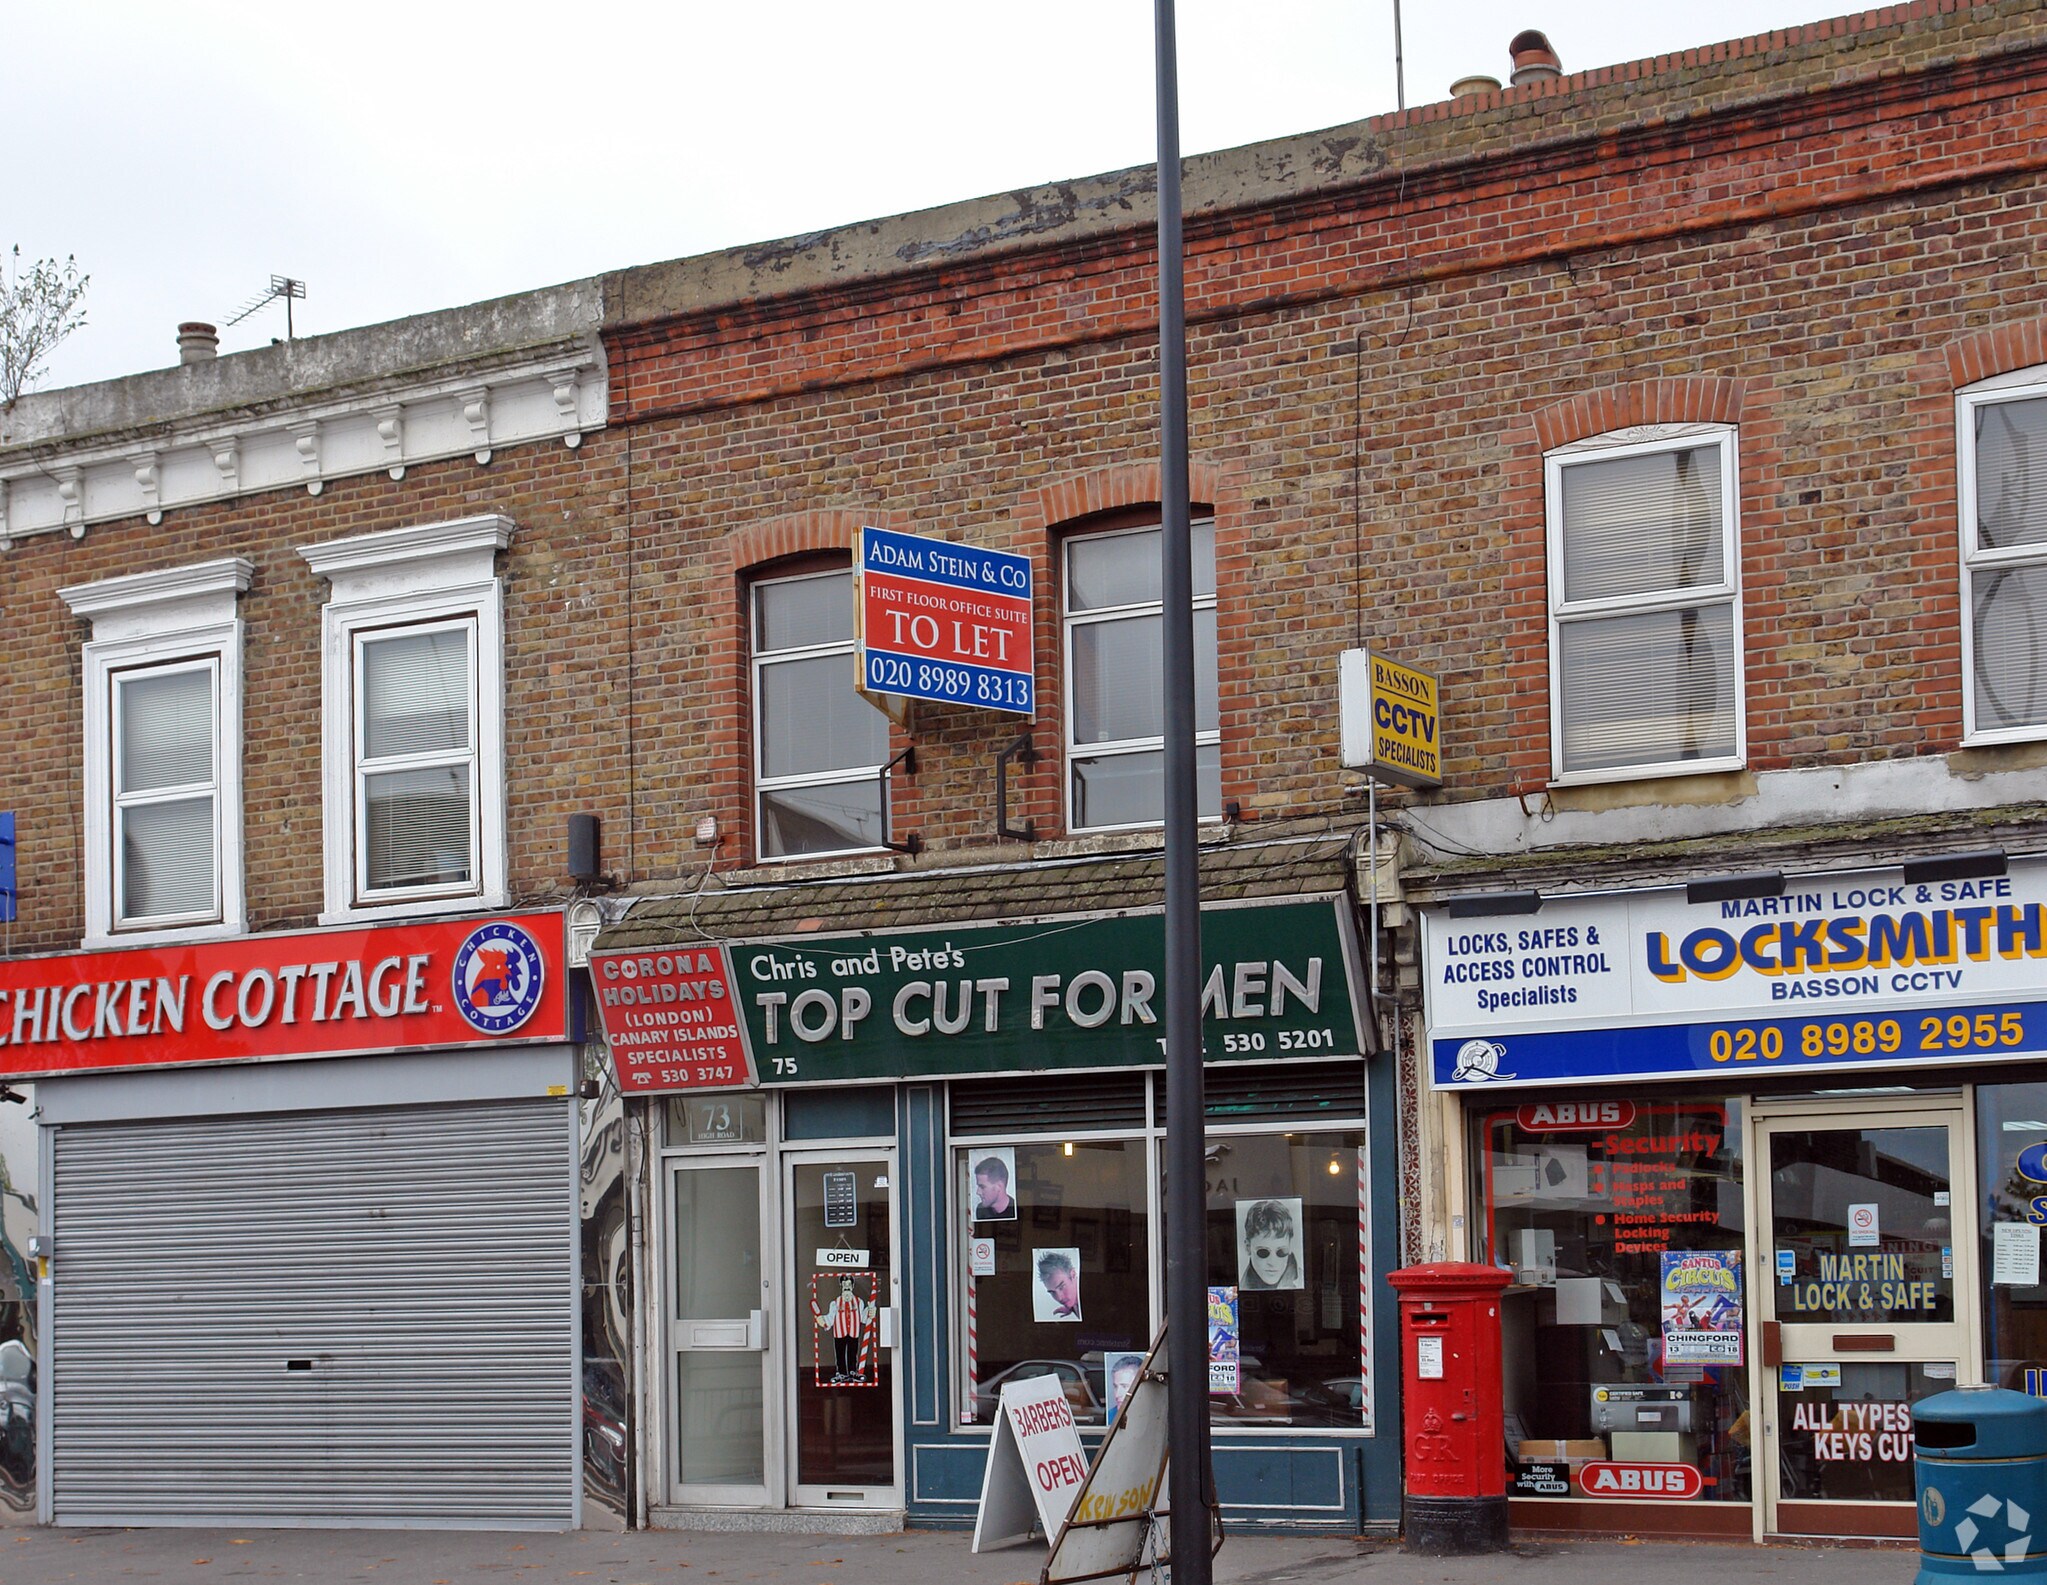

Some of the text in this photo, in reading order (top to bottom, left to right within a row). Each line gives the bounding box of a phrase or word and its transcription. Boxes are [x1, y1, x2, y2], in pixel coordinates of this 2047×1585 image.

[982, 561, 997, 583] &
[870, 586, 1028, 624] FIRST FLOOR OFFICE SUITE
[885, 609, 1013, 661] TO LET
[871, 657, 1028, 705] 020 8989 8313
[1375, 664, 1430, 700] BASSON
[1375, 698, 1435, 743] CCTV
[1378, 737, 1436, 773] SPECIALISTS
[1721, 878, 2012, 919] MARTIN LOCK & SAFE
[459, 927, 537, 967] CHICKEN
[1448, 926, 1600, 956] LOCKS, SAFES &
[603, 954, 714, 980] CORONA
[750, 941, 965, 981] Chris and Pete's
[1443, 952, 1611, 984] ACCESS CONTROL
[203, 954, 431, 1031] COTTAGE
[603, 980, 725, 1007] HOLIDAYS
[1477, 985, 1577, 1012] Specialists
[1772, 970, 1963, 1000] BASSON CCTV
[461, 996, 533, 1028] COTTAGE
[625, 1006, 713, 1027] (LONDON)
[756, 986, 872, 1044] TOP
[893, 976, 1010, 1037] CUT
[1031, 969, 1158, 1030] FOR
[609, 1025, 738, 1046] CANARY ISLANDS
[1223, 1033, 1266, 1052] 530
[1278, 1029, 1334, 1049] 5201
[1709, 1012, 2024, 1063] 020 8989 2955
[628, 1046, 727, 1065] SPECIALISTS
[772, 1057, 798, 1075] 75
[661, 1066, 733, 1082] 530 3747
[701, 1104, 730, 1131] 73
[1531, 1101, 1621, 1124] ABUS
[1612, 1161, 1676, 1174] Padlocks
[1612, 1179, 1686, 1195] Hasps and
[1612, 1195, 1664, 1209] Staples
[1614, 1211, 1720, 1226] Home Security
[1615, 1227, 1670, 1240] Locking
[827, 1253, 859, 1263] OPEN
[1615, 1242, 1668, 1254] Devices
[1681, 1257, 1722, 1271] SANTUS
[1820, 1254, 1905, 1282] MARTIN
[1665, 1267, 1738, 1292] CIRCUS
[1794, 1282, 1937, 1311] LOCK & SAFE
[1667, 1334, 1739, 1343] CHINGFORD
[1784, 1382, 1800, 1390] PUSH
[1012, 1396, 1072, 1438] BARBERS
[1793, 1403, 1910, 1432] ALL TYPES
[1414, 1433, 1460, 1461] GR
[1815, 1432, 1873, 1461] KEYS
[1037, 1453, 1086, 1492] OPEN
[1521, 1473, 1555, 1482] Security
[1594, 1469, 1686, 1491] ABUS
